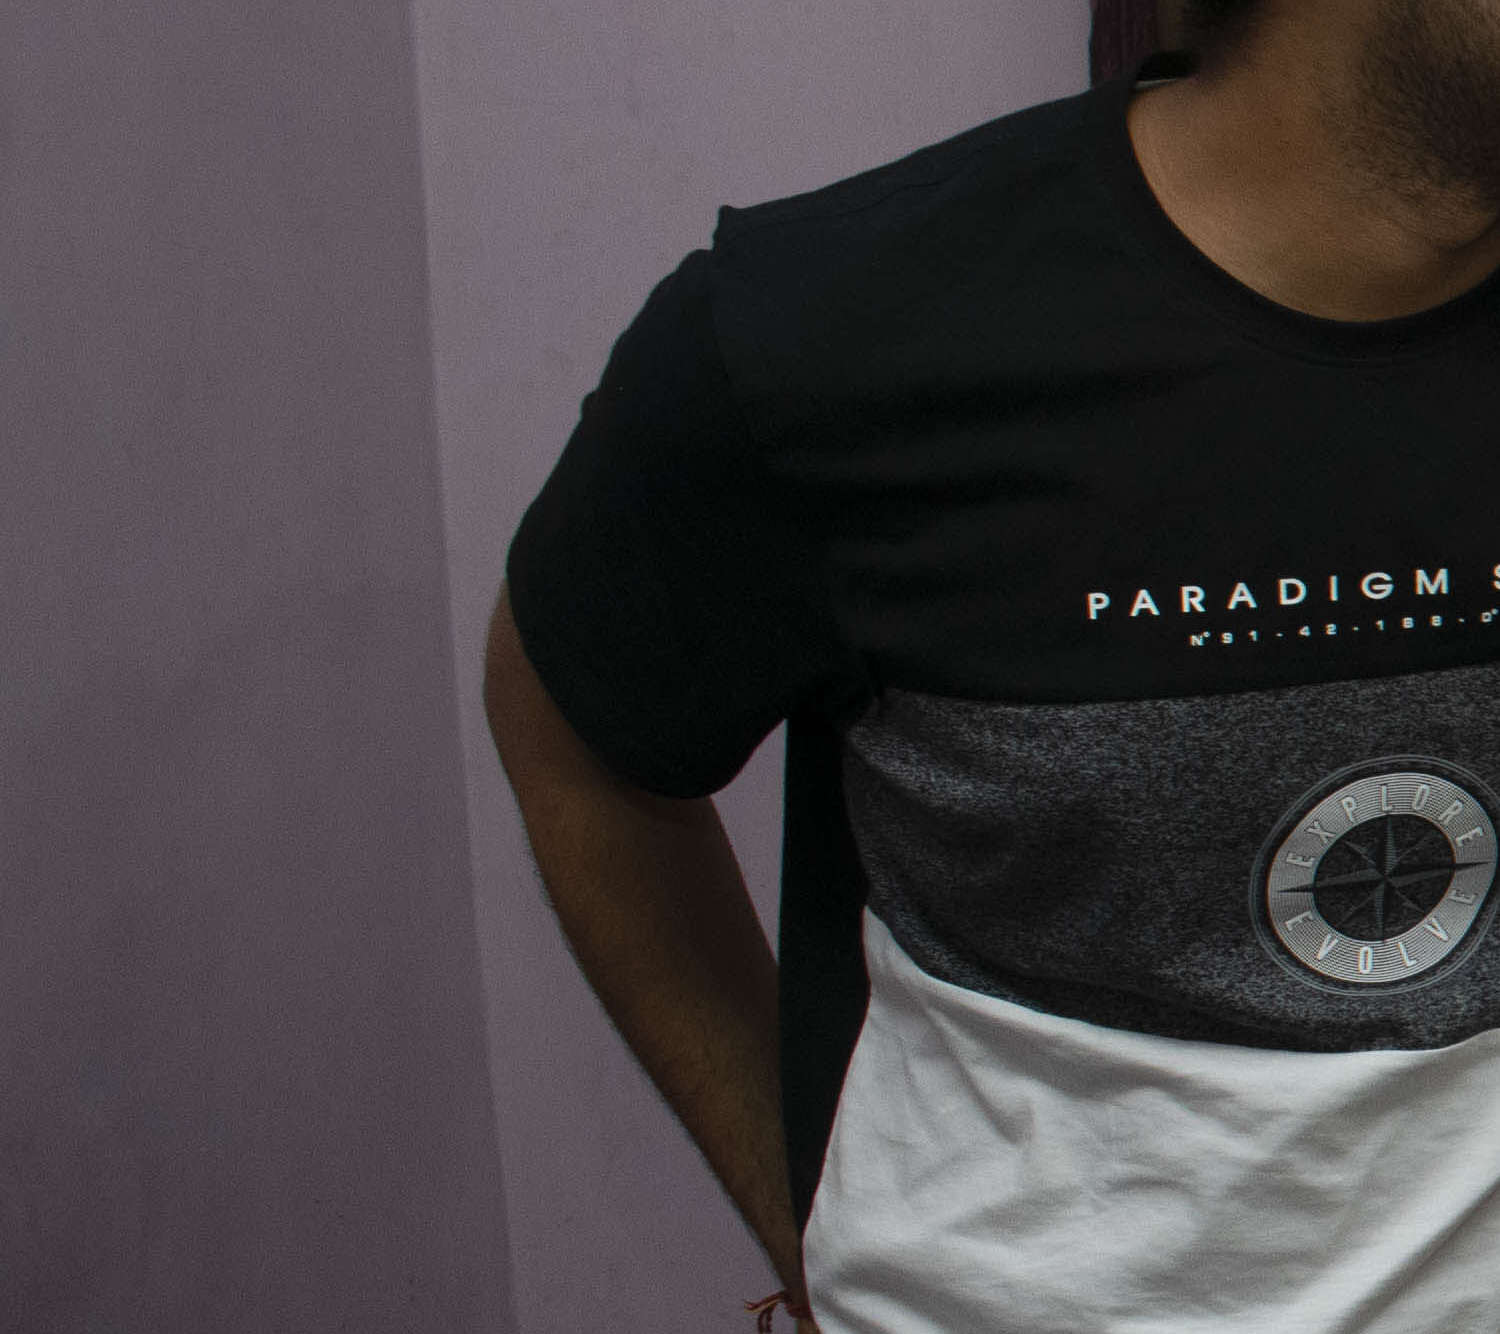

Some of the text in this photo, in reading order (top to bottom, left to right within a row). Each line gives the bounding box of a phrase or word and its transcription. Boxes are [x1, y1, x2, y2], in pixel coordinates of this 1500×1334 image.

[1084, 567, 1450, 620] PARADIGM
[1286, 783, 1485, 869] EXPLORE
[1284, 888, 1479, 975] EVOLVE
